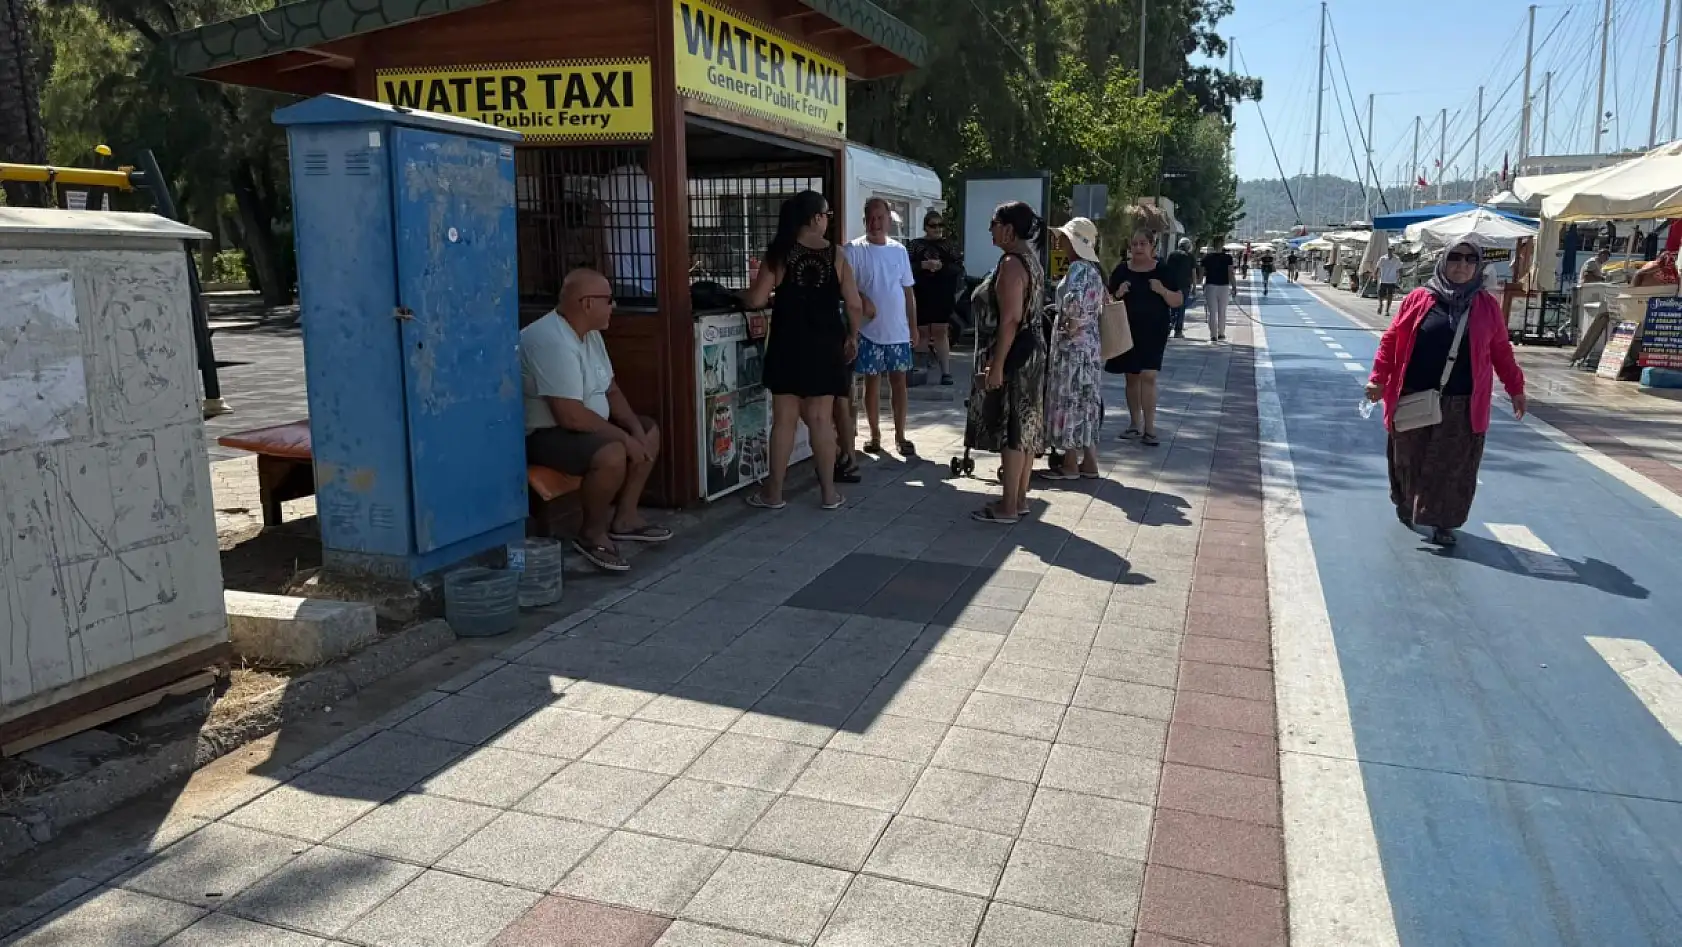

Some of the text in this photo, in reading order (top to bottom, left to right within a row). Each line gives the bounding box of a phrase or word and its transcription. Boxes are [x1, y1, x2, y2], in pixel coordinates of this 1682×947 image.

[680, 3, 839, 106] WATER TAXI
[384, 71, 634, 113] WATER TAXI
[707, 66, 829, 123] General Public Ferry
[494, 111, 553, 127] Public
[559, 111, 611, 128] Ferry
